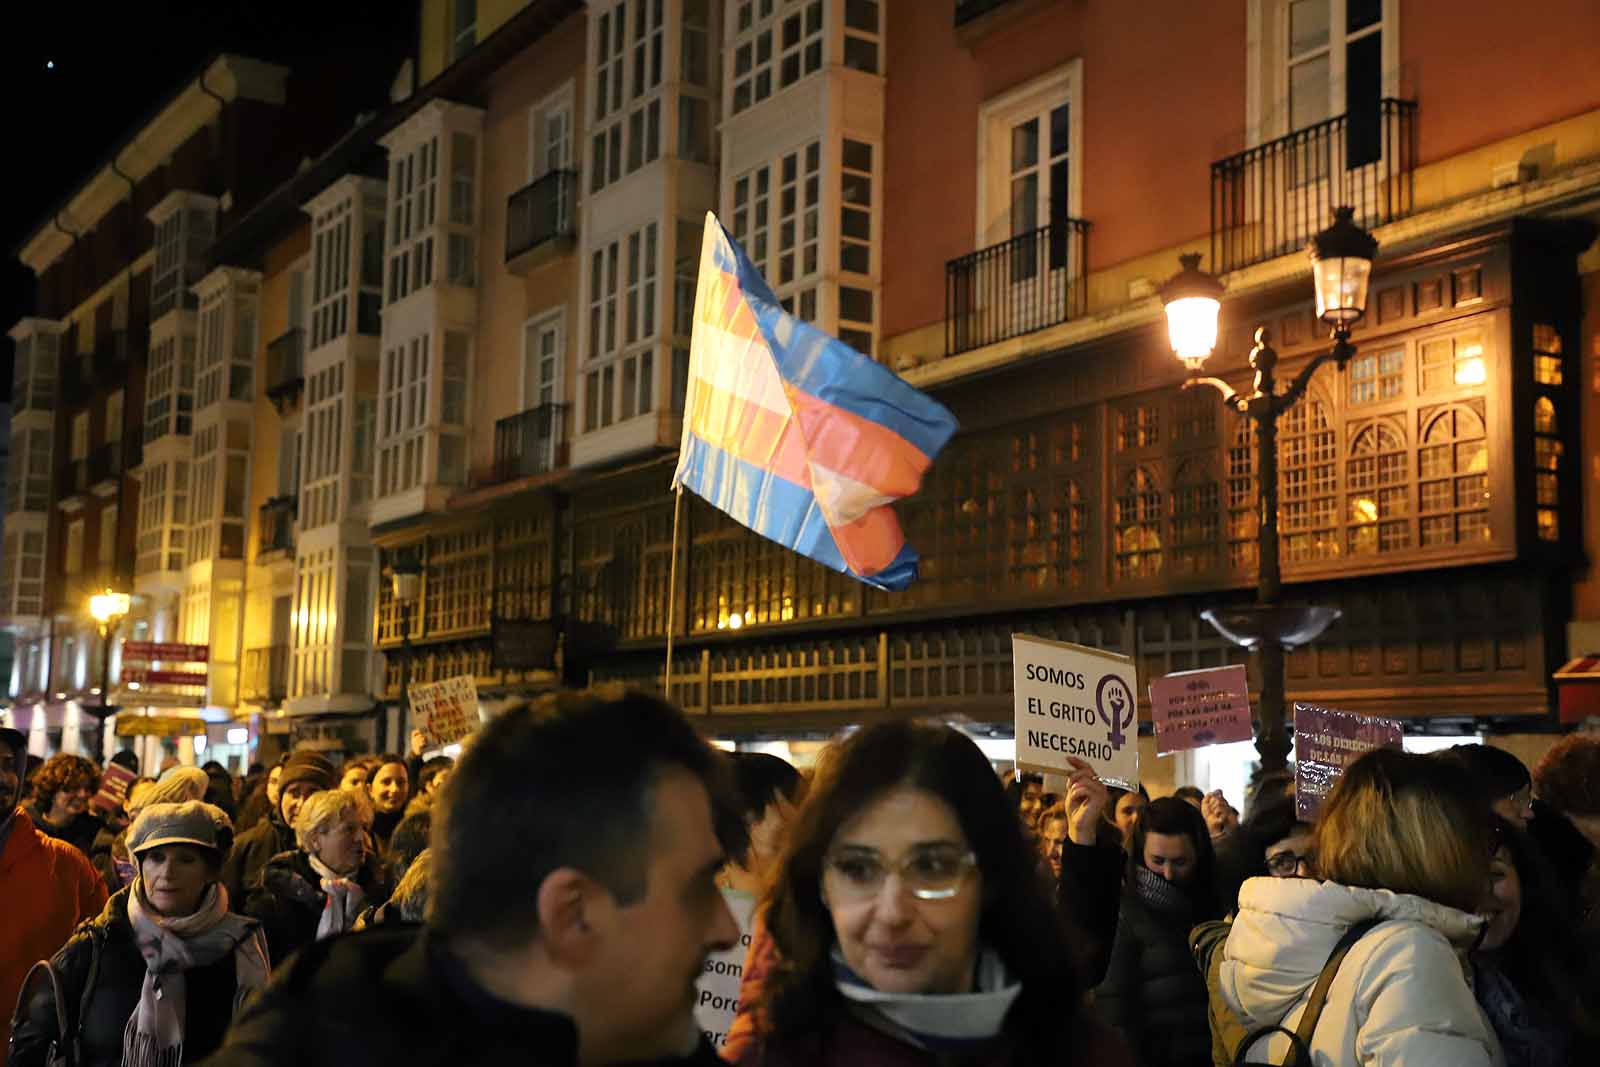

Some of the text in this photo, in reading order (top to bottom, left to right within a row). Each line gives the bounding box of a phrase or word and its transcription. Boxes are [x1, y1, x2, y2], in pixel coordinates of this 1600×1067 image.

[1026, 663, 1085, 690] SOMOS
[1028, 697, 1096, 726] EL GRITO
[1028, 729, 1112, 761] NECESARIO
[704, 959, 743, 977] som
